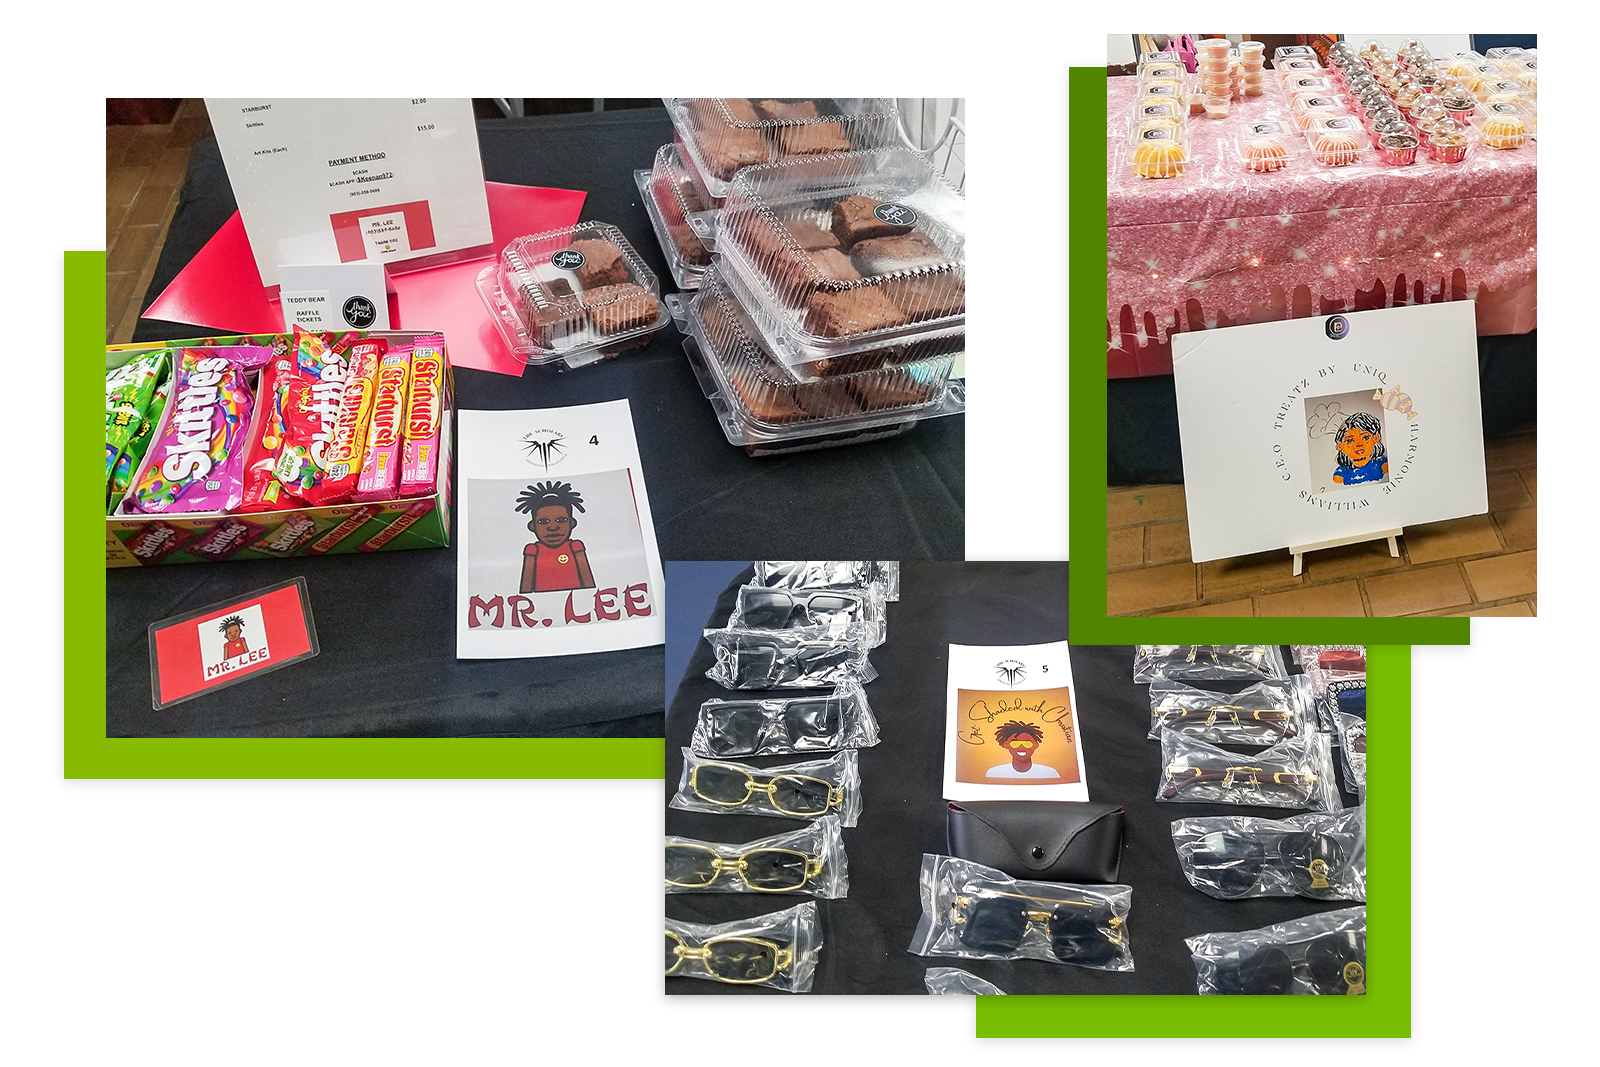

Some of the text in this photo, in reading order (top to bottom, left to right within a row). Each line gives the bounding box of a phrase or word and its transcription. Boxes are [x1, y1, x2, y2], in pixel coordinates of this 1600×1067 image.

[241, 104, 272, 113] STARBURST
[417, 124, 435, 132] $15.00
[272, 146, 288, 154] (Each)
[328, 151, 386, 167] PAYMENT METHOD
[373, 367, 403, 445] Starburst
[408, 360, 438, 439] Starburst
[1273, 363, 1388, 430] TREATZ BY UNIQ
[162, 357, 229, 482] Skittles
[534, 428, 564, 438] SCHOLARS
[588, 434, 600, 446] 4
[1272, 423, 1419, 511] HARMONIE WILLIAMS C.E.O
[133, 527, 175, 558] Skittles
[202, 523, 248, 554] Skittles
[270, 519, 315, 552] Skittles
[316, 520, 358, 551] Starburst
[369, 514, 412, 546] Starburst
[468, 582, 651, 629] MR. LEE
[207, 647, 268, 678] MR. LEE
[1042, 664, 1049, 673] 5
[968, 697, 1023, 723] Shaded
[1024, 699, 1046, 714] with
[1041, 705, 1073, 744] Christian
